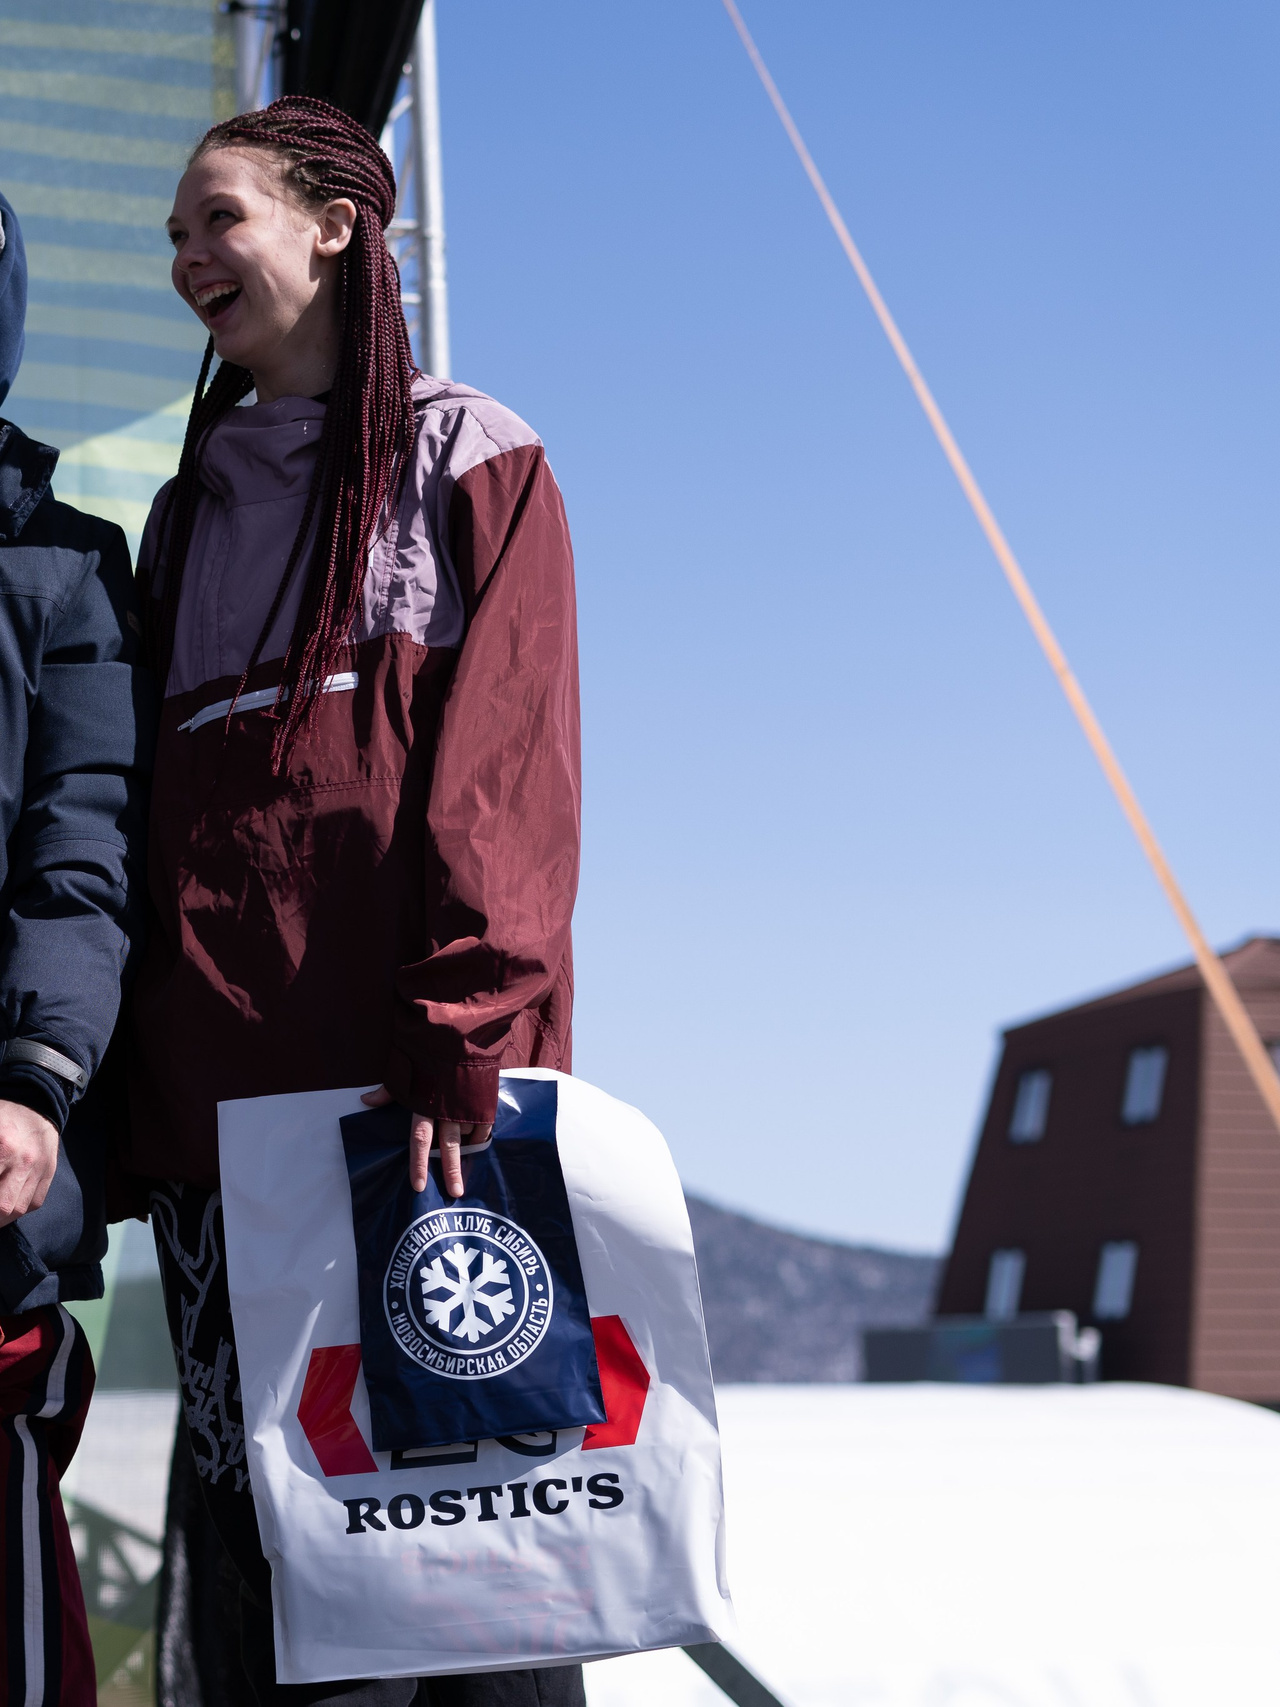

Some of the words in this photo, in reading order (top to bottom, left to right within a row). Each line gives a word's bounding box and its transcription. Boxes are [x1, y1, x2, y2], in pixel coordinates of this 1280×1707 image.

[390, 1213, 451, 1290] ХОККЕЙНЫЙ
[453, 1215, 493, 1235] КЛУБ
[494, 1225, 541, 1276] СИБИРЬ
[392, 1312, 508, 1375] НОВОСИБИРСКАЯ
[506, 1298, 549, 1360] ОБЛАСТЬ
[343, 1472, 625, 1535] ROSTIC'S
